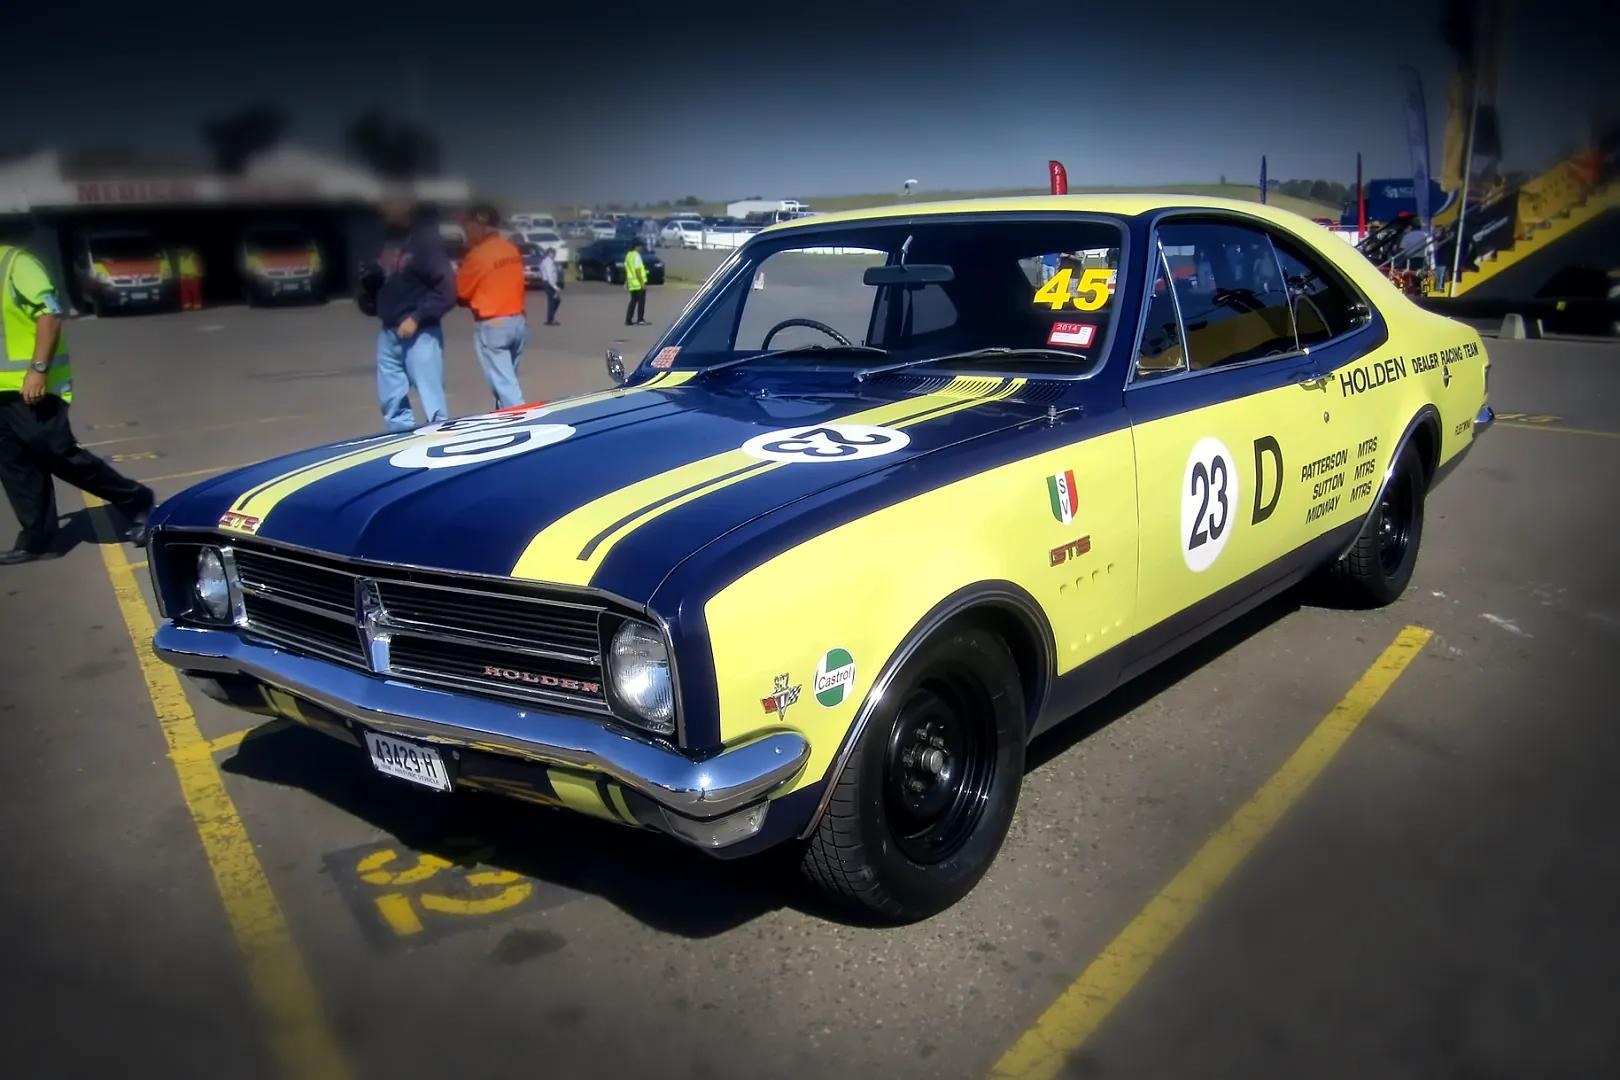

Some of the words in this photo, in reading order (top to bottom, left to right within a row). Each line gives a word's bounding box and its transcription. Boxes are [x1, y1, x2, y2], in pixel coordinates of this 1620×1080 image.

[1033, 268, 1113, 311] 45
[1340, 356, 1407, 397] HOLDEN
[1411, 353, 1439, 374] DEALER
[1440, 346, 1463, 366] RACING
[1463, 342, 1479, 359] TEAM
[1301, 448, 1349, 482] PATTERSON
[1357, 436, 1377, 458] MTRS
[1312, 472, 1345, 500] SUTTON
[1354, 458, 1375, 480] MTRS
[1188, 455, 1228, 551] 23
[1251, 435, 1284, 526] D
[1305, 494, 1341, 524] MIDWAY
[1349, 480, 1372, 503] MTRS
[1050, 535, 1091, 567] GTS
[482, 665, 600, 693] HOLDEN
[818, 666, 852, 690] Castrol
